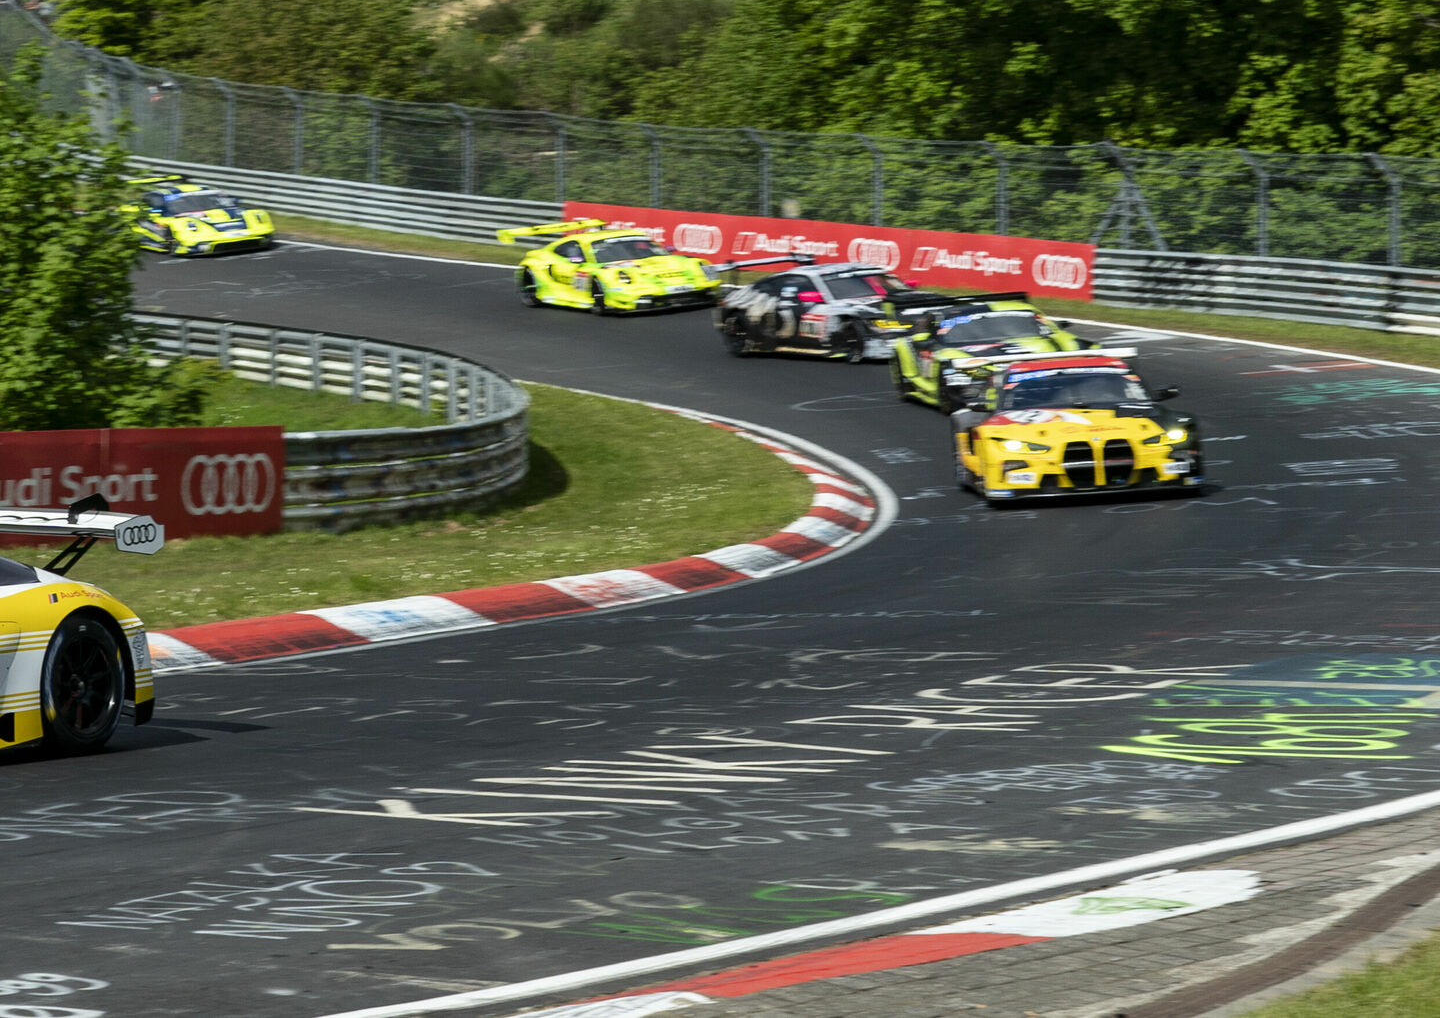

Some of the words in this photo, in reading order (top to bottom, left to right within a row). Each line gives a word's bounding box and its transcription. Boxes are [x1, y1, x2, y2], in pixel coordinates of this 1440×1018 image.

[291, 735, 898, 827] KINKY
[782, 663, 1252, 732] RACER
[467, 802, 926, 849] HOLGER
